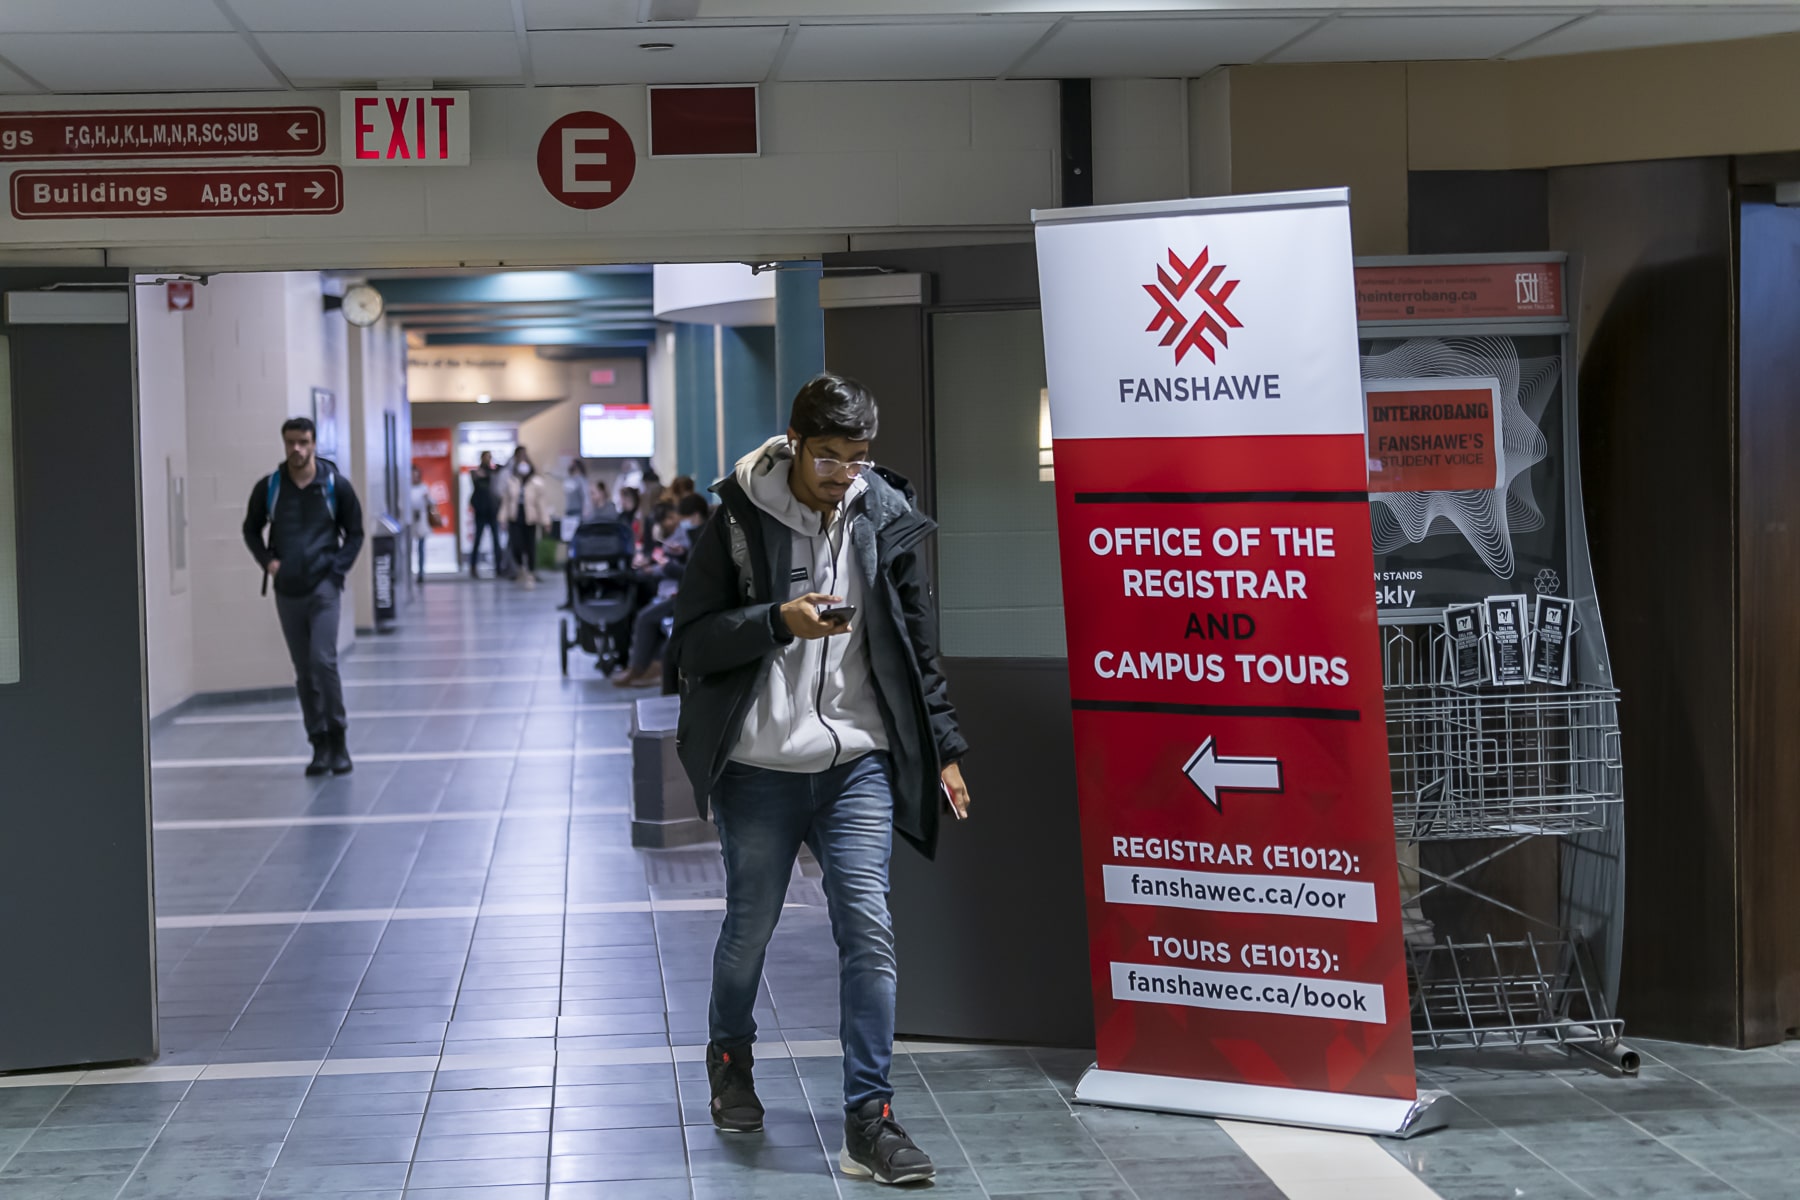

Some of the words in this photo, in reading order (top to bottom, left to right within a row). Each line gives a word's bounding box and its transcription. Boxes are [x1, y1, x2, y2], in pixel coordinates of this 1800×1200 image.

[355, 97, 455, 159] EXIT
[561, 128, 611, 193] E
[33, 183, 168, 206] Buildings
[201, 182, 286, 206] A,B,C,S,T
[1119, 374, 1281, 403] FANSHAWE
[1372, 403, 1489, 422] INTERROBANG
[1378, 433, 1484, 452] FANSHAWE'S
[1380, 454, 1442, 468] STUDENT
[1444, 453, 1484, 465] VOICE
[1088, 527, 1202, 557] OFFICE
[1212, 527, 1261, 557] OF
[1270, 527, 1336, 557] THE
[1123, 569, 1308, 599] REGISTRAR
[1383, 571, 1423, 581] STANDS
[1375, 585, 1416, 608] ekly
[1184, 612, 1256, 640] AND
[1094, 650, 1226, 682] CAMPUS
[1234, 654, 1349, 686] TOURS
[1112, 836, 1253, 866] REGISTRAR
[1262, 845, 1360, 875] (E1012):
[1131, 874, 1346, 909] fanshawec.ca/oor
[1148, 936, 1231, 963] TOURS
[1240, 944, 1339, 974] (E1013):
[1128, 971, 1367, 1012] fanshawec.ca/book
